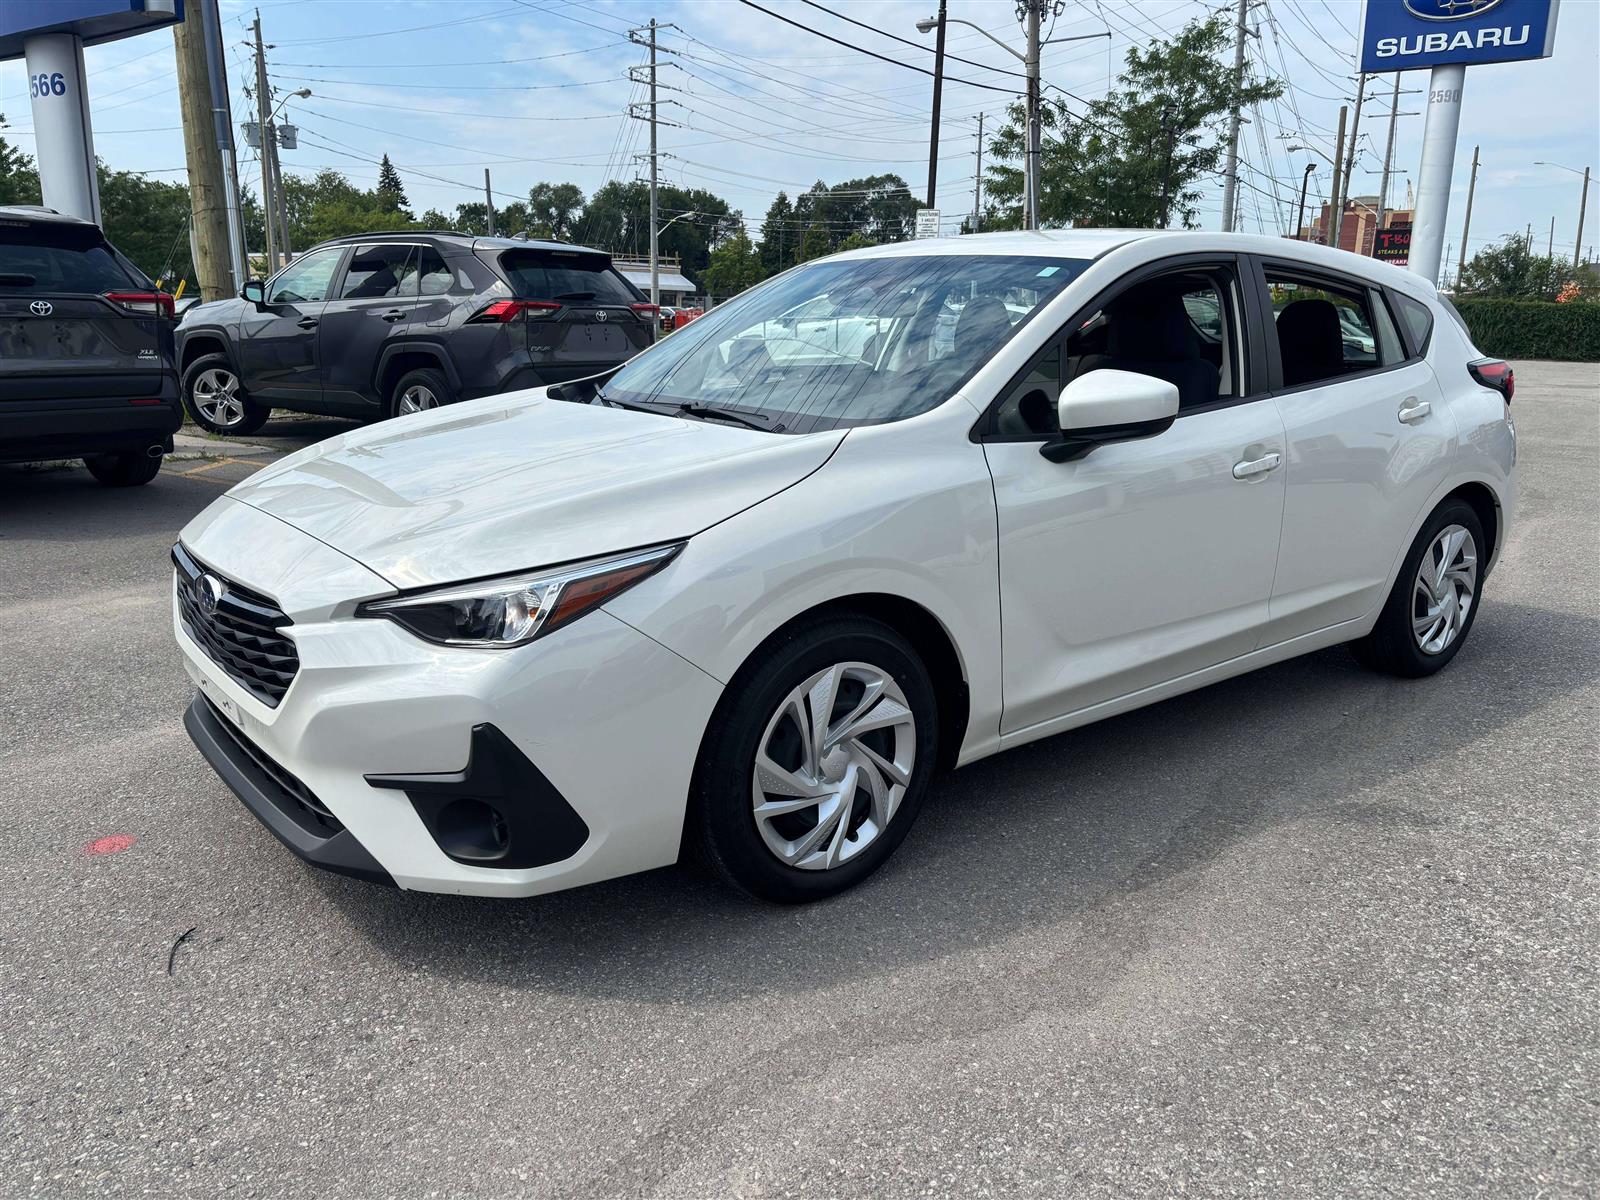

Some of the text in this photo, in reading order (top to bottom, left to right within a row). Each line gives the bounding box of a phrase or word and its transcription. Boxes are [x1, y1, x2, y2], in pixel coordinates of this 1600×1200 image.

[1376, 25, 1530, 58] SUBARU
[31, 73, 66, 99] 566
[1429, 89, 1461, 104] 2590
